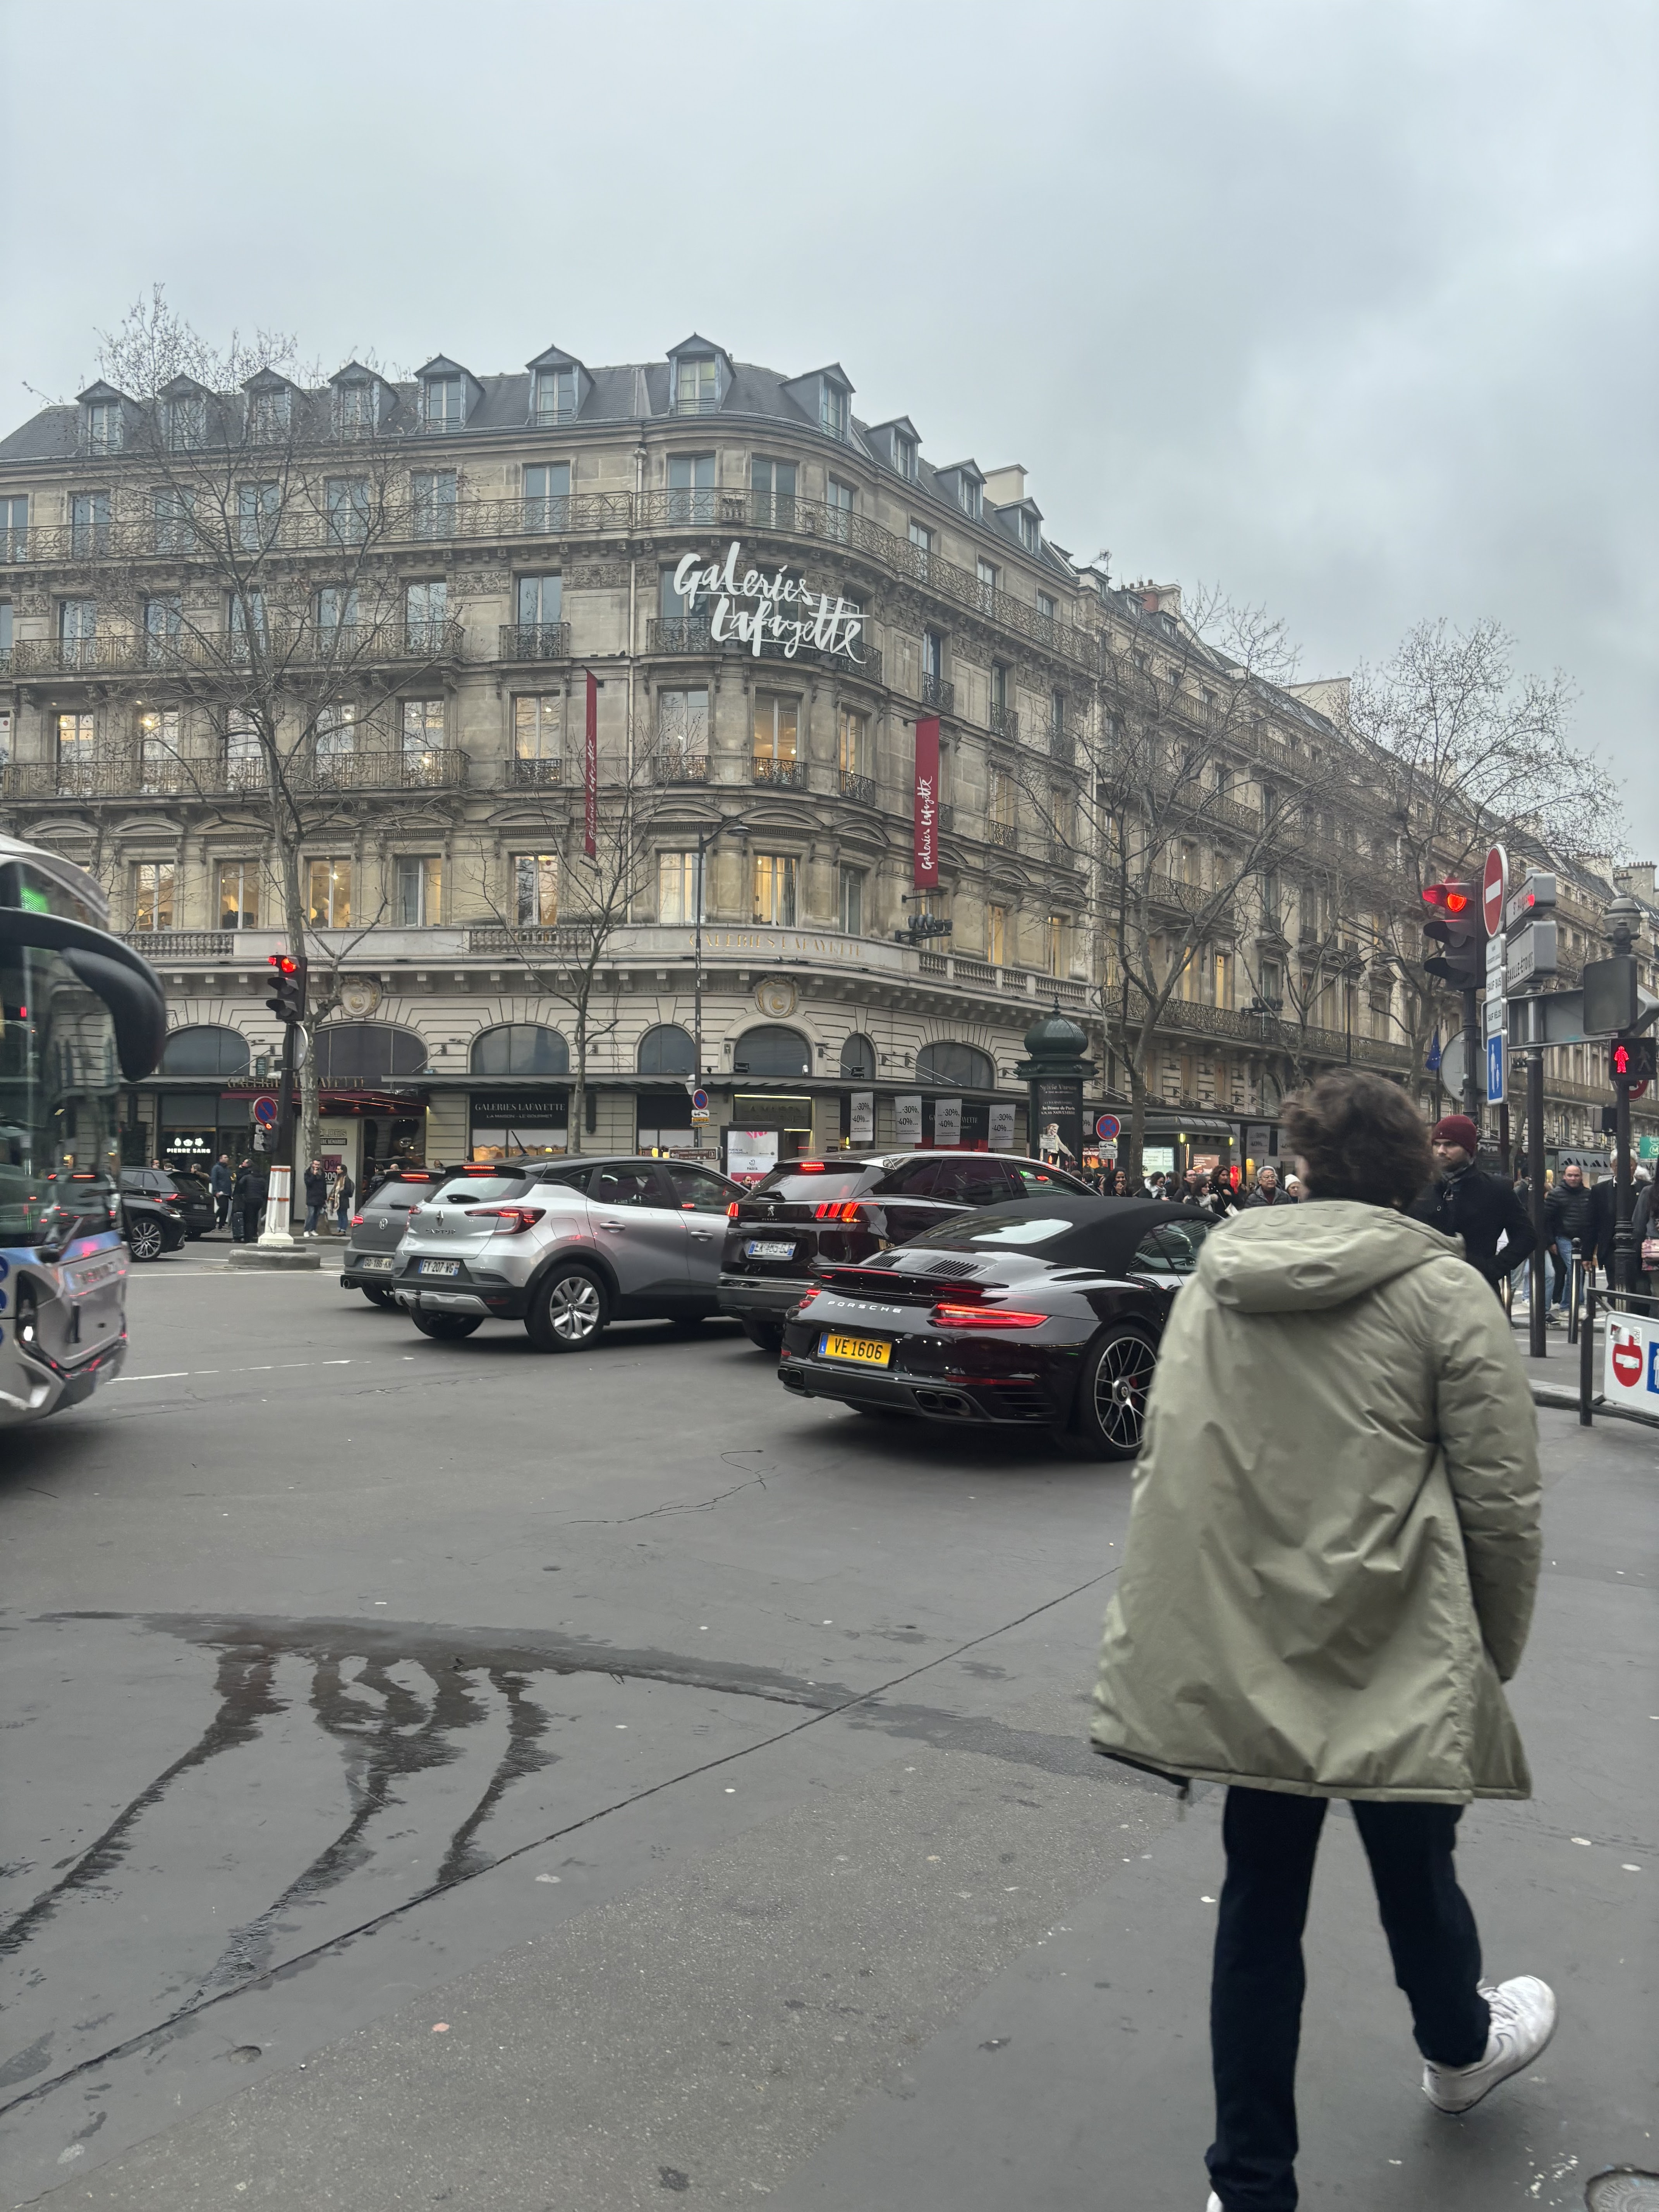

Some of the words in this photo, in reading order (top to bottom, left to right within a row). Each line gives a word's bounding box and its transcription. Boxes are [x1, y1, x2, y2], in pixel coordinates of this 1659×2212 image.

[673, 541, 813, 609] Galeries
[711, 593, 870, 664] Lafayette
[917, 776, 935, 825] Lafayette
[917, 828, 935, 869] Galeries
[828, 1300, 902, 1314] PORSCHE
